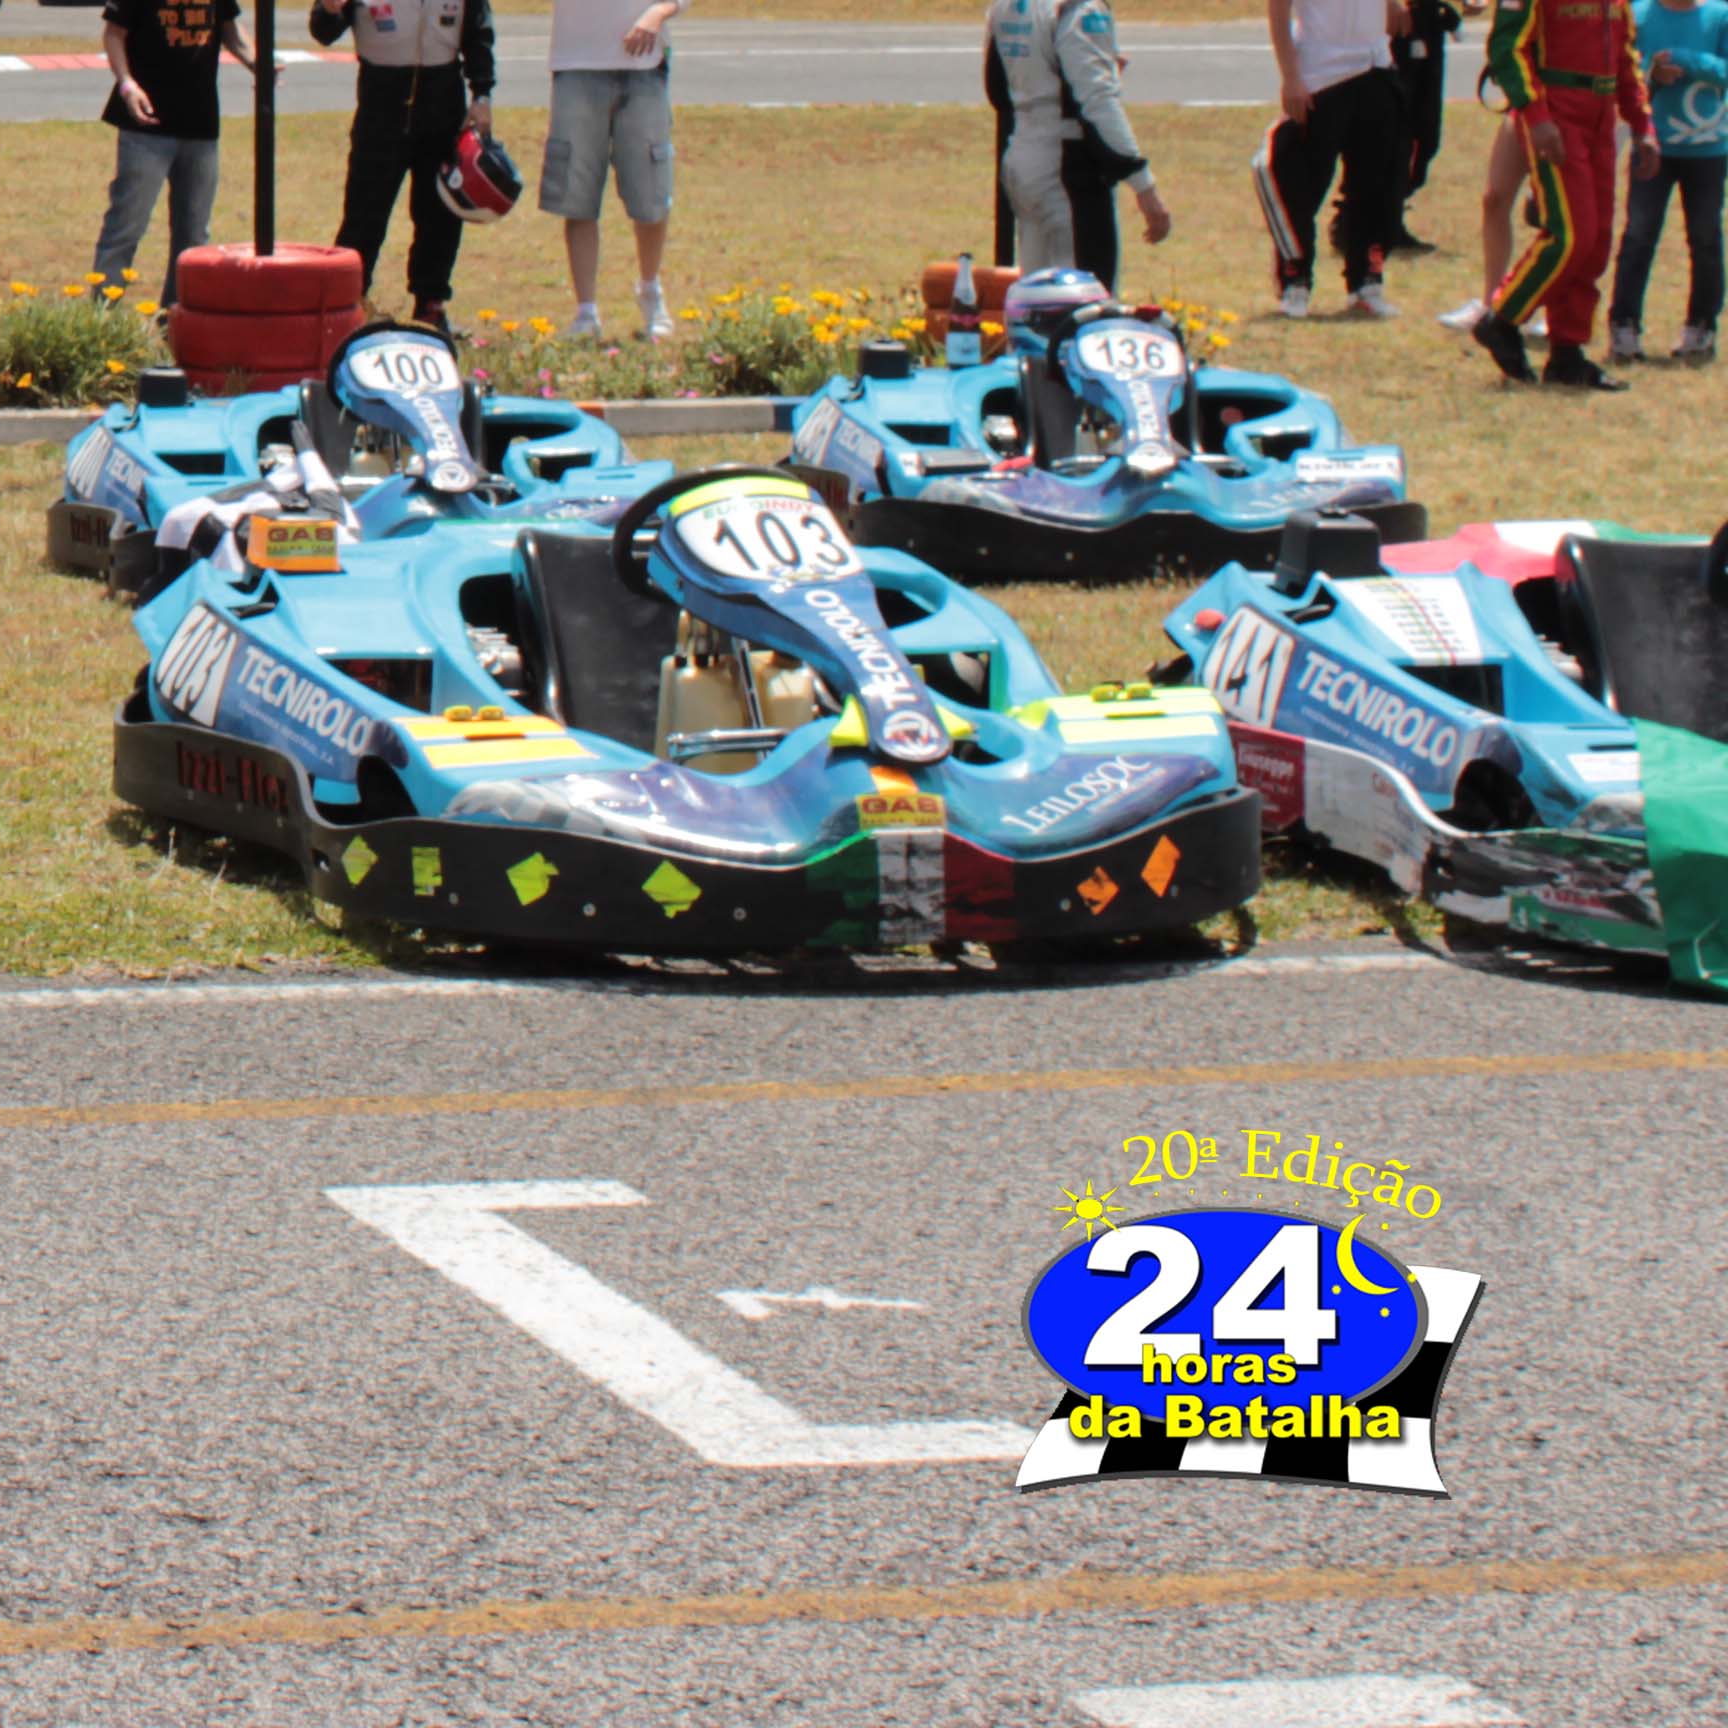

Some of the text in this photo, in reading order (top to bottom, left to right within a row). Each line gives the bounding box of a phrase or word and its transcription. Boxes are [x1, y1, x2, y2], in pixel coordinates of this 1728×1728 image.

[373, 352, 443, 385] 100
[1097, 336, 1166, 370] 136
[712, 510, 850, 572] 103
[804, 589, 919, 710] TECNIROLO
[237, 645, 375, 757] TECNIROLO
[1297, 650, 1458, 767] TECNIROLO
[1001, 755, 1152, 835] LEILOSOC
